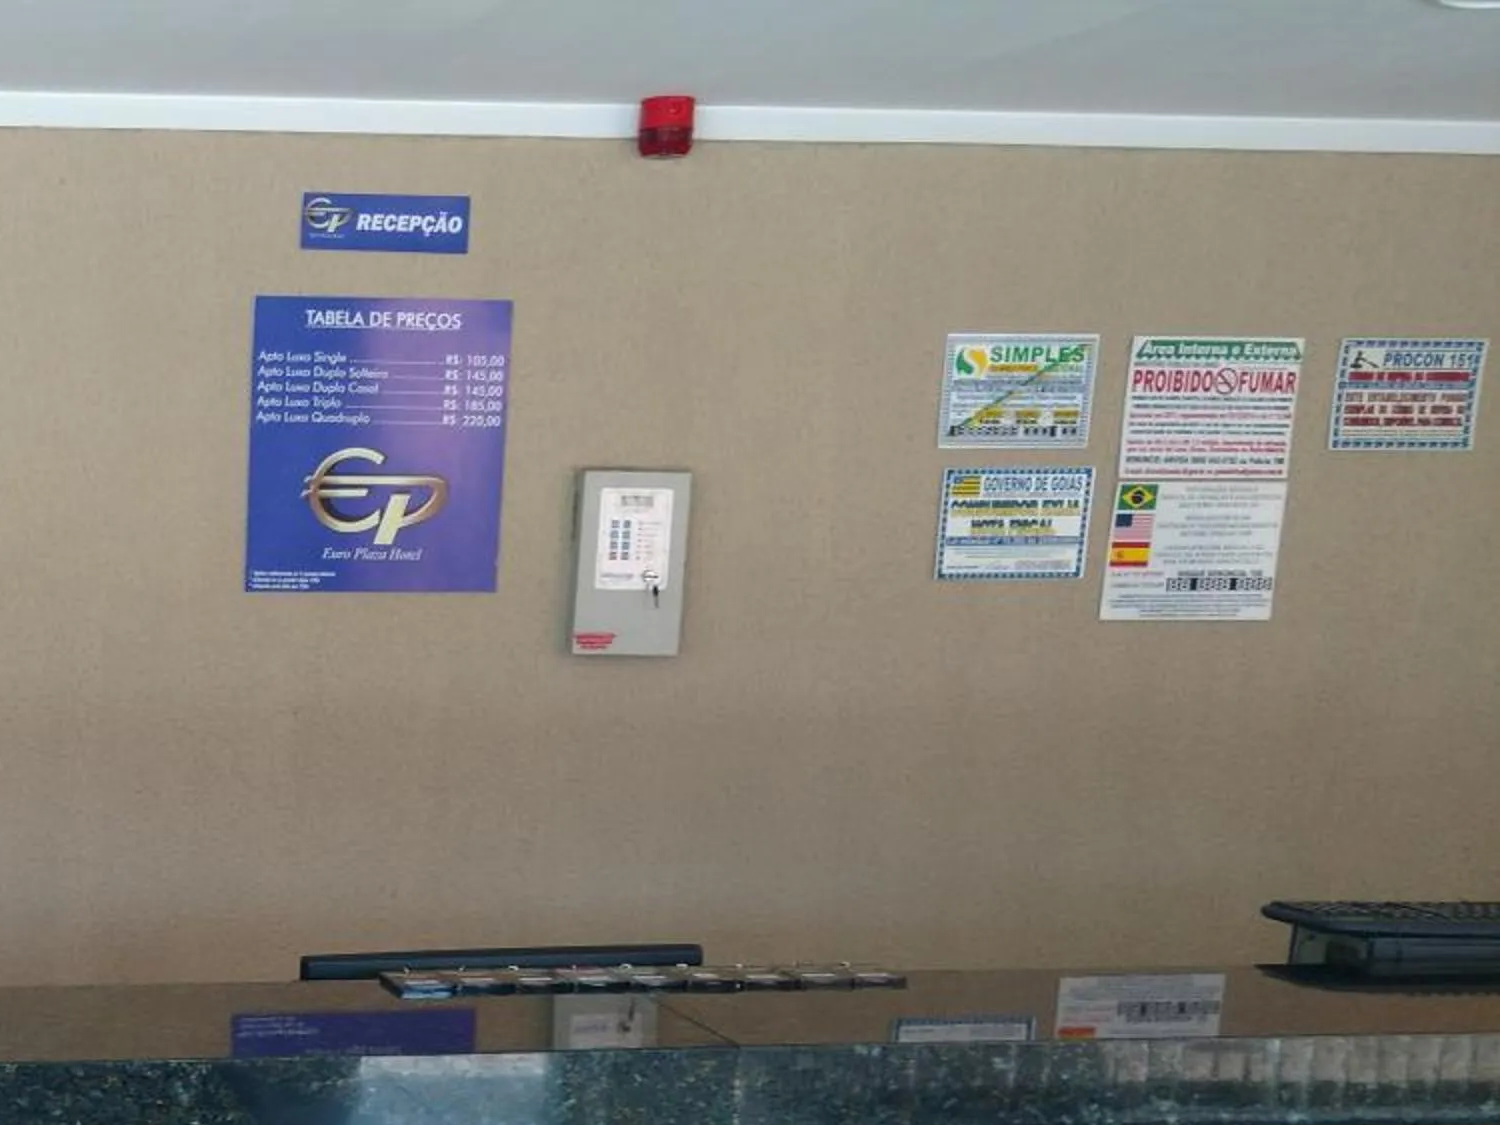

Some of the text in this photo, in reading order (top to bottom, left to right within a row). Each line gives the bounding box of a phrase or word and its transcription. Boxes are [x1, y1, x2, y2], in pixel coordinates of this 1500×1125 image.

[356, 211, 463, 237] RECEPÇÃO
[306, 309, 462, 331] TABELA DE PREÇOS
[989, 345, 1085, 363] SIMPLES
[1178, 341, 1228, 356] Interna
[1243, 343, 1299, 359] Externa
[258, 352, 284, 365] Apto
[286, 352, 312, 363] Luxo
[313, 352, 347, 365] Single
[1383, 353, 1445, 367] PROCON
[258, 366, 284, 379] Apto
[286, 366, 311, 377] Luxo
[313, 366, 347, 380] Duplo
[348, 367, 389, 379] Solteiro
[258, 381, 283, 394] Apto
[285, 381, 311, 392] Luxo
[312, 381, 346, 395] Duplo
[347, 382, 379, 394] Casal
[1132, 369, 1298, 395] PROIBIDO FUMAR
[257, 396, 283, 408] Apto
[284, 396, 310, 407] Luxo
[312, 396, 342, 409] Triplo
[256, 411, 282, 424] Apto
[283, 412, 309, 423] Luxo
[462, 415, 501, 428] 220,00
[983, 476, 1033, 491] GOVERNO
[1035, 476, 1049, 491] DE
[322, 546, 423, 561] Euro Plaza Hotel
